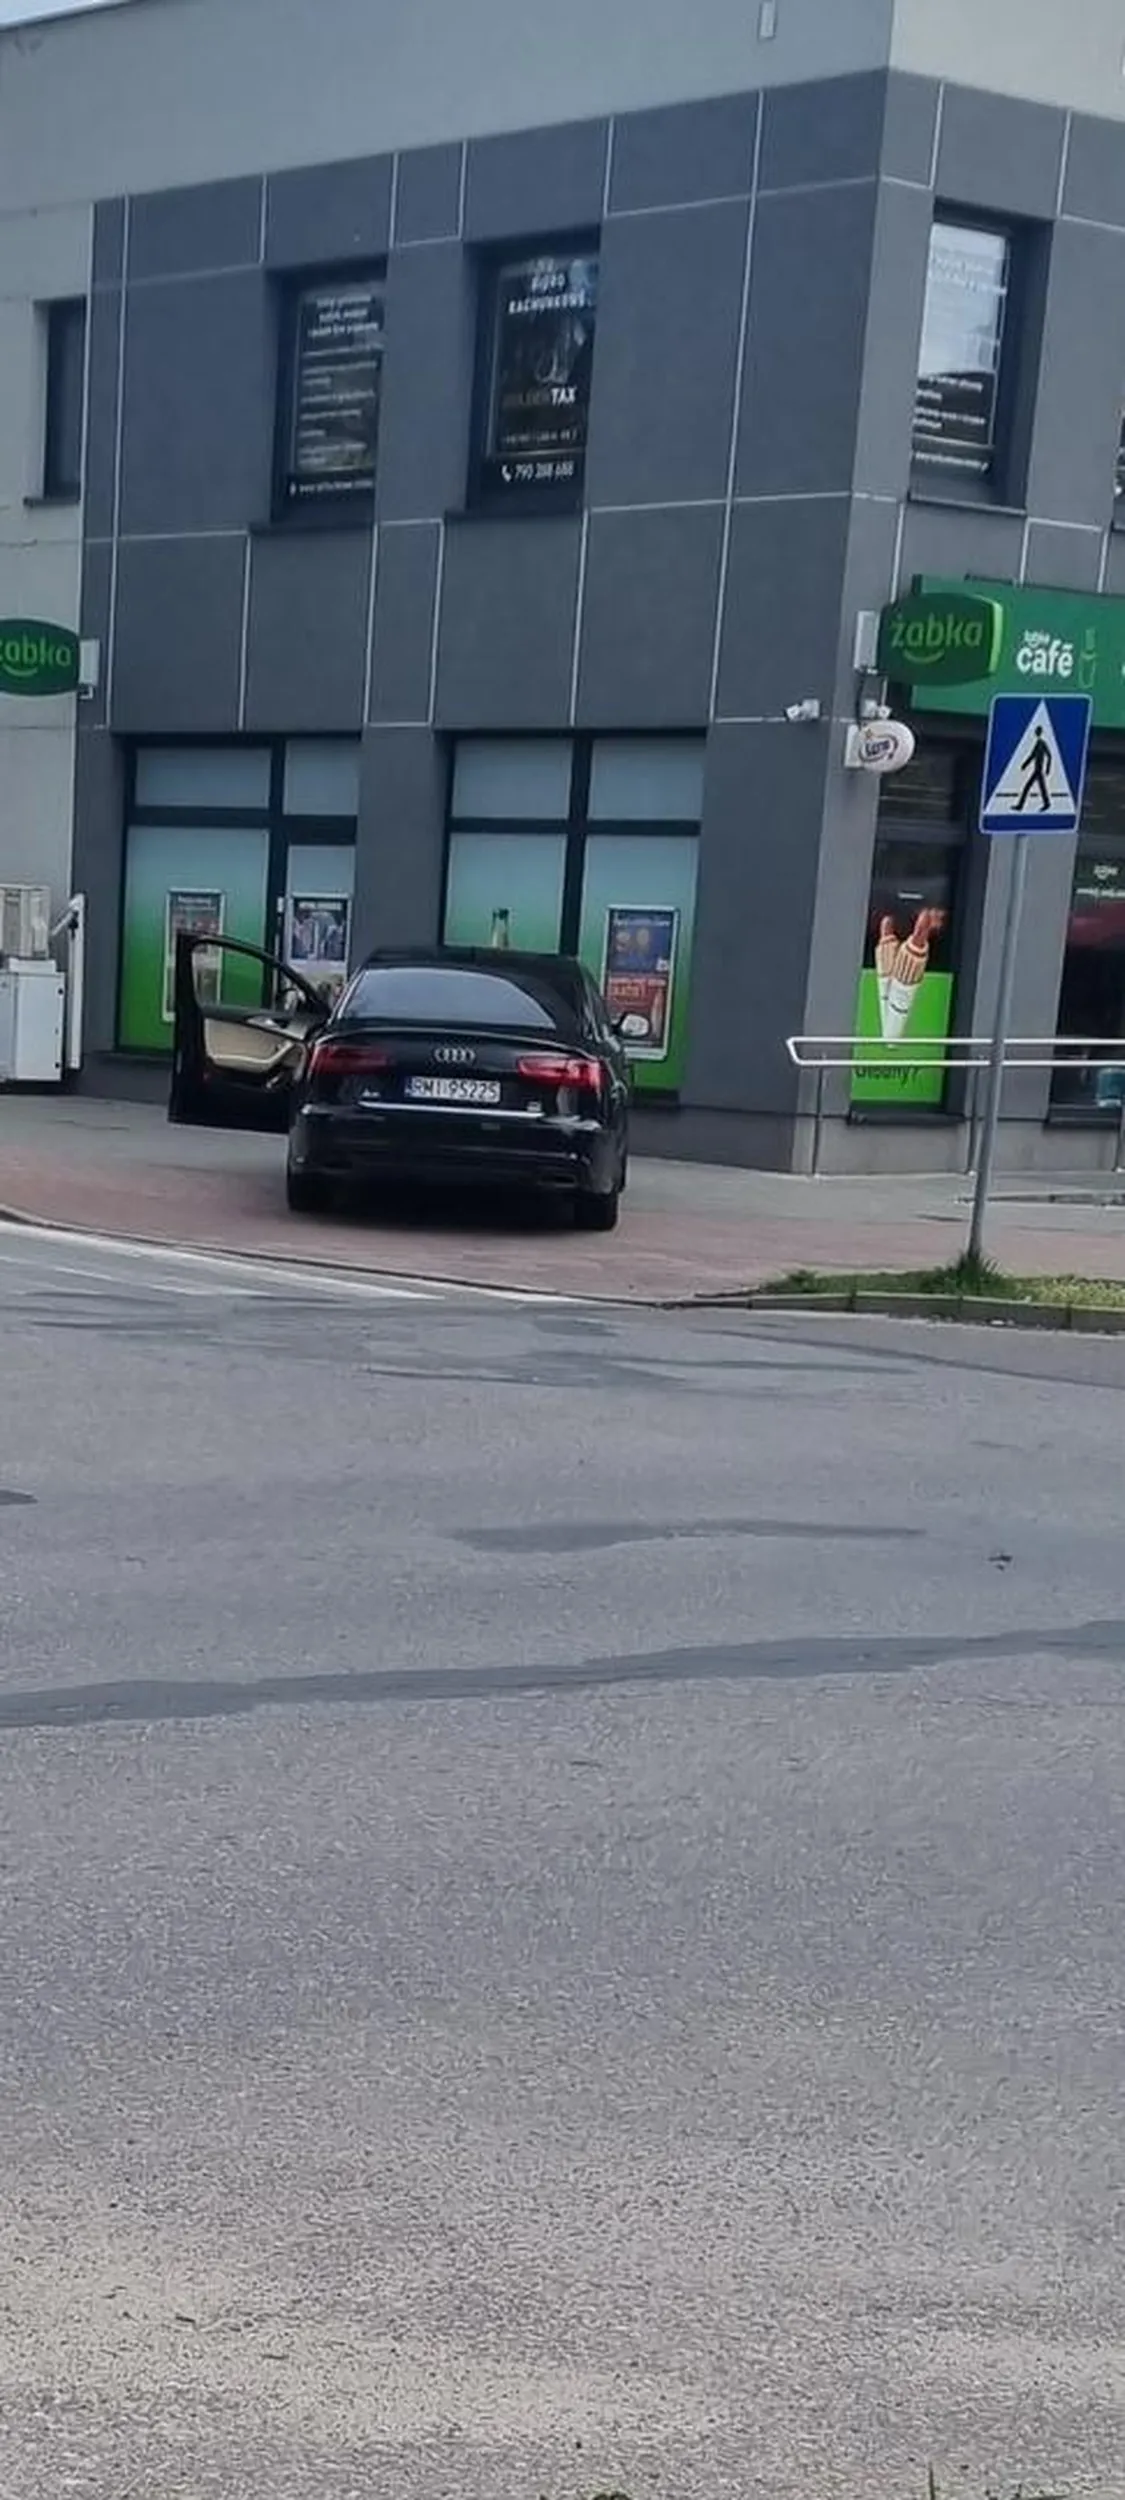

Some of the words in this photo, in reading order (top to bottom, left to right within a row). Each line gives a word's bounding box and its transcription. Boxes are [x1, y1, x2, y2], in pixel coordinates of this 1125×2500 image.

[890, 611, 983, 648] żabka
[1016, 638, 1074, 677] café
[448, 1080, 498, 1101] 95225
